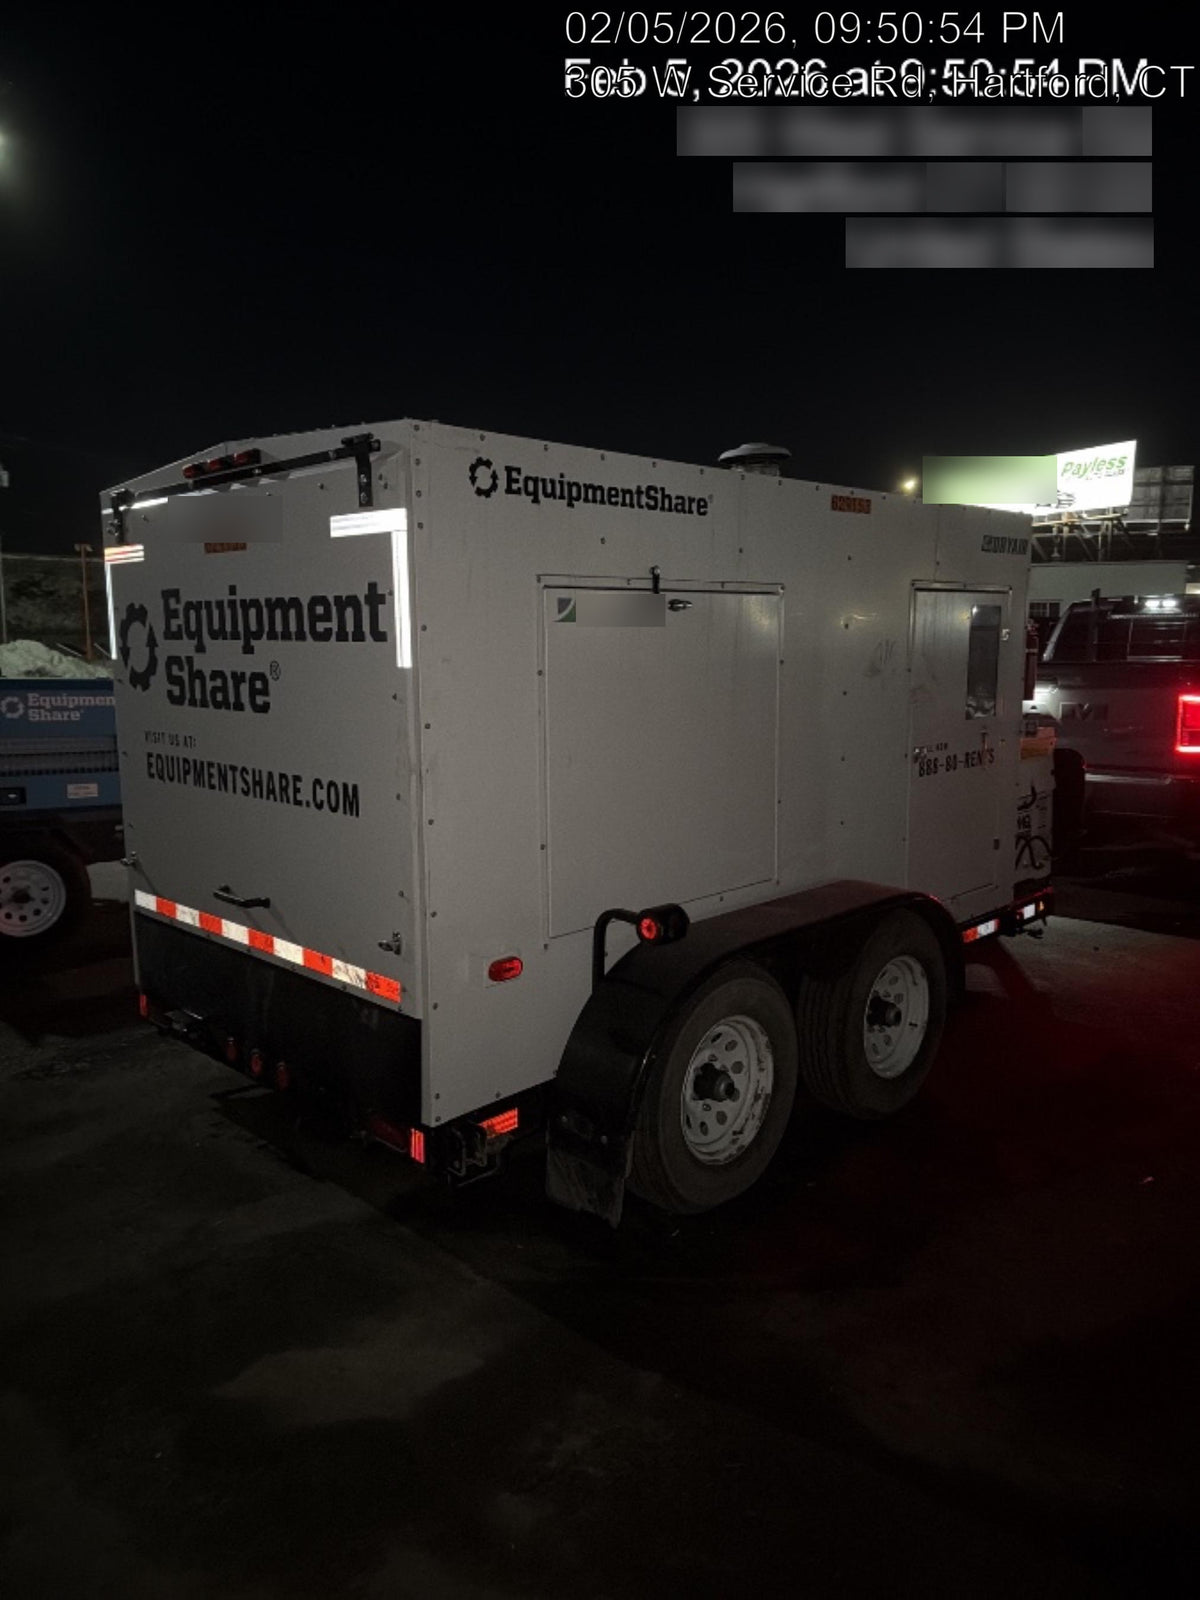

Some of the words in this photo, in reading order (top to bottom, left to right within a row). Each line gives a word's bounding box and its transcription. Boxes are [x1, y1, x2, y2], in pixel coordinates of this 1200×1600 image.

[1061, 456, 1128, 479] Payless
[504, 465, 708, 516] EquipmentShare
[161, 582, 388, 654] Equipment
[27, 693, 116, 709] Equipmen
[28, 709, 81, 721] Share
[144, 730, 166, 744] VISIT
[169, 733, 180, 747] US
[183, 735, 197, 750] AT:
[918, 748, 995, 777] 888-80-RENS
[146, 752, 361, 818] EQUIPMENTSHARE.COM
